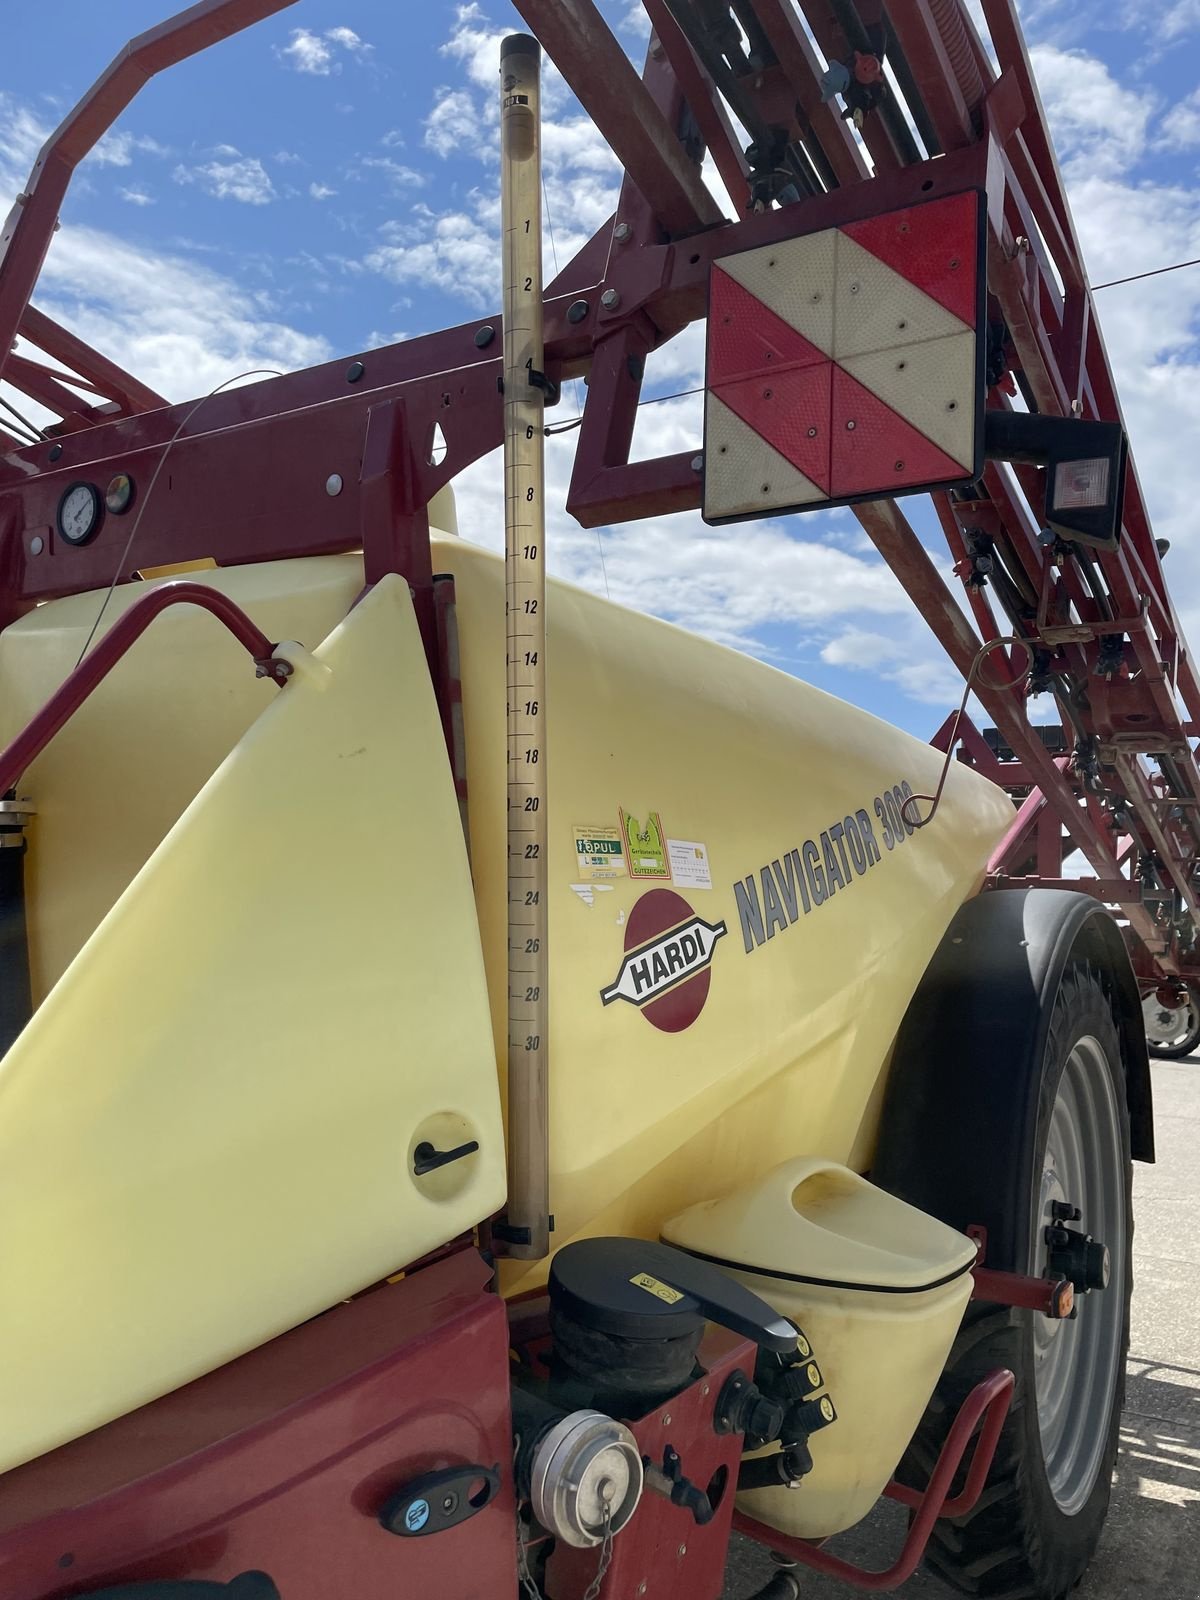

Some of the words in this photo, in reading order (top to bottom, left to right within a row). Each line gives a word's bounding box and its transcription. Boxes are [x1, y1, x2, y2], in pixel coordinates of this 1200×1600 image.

[524, 219, 530, 233] 1
[524, 277, 532, 291] 2
[525, 357, 533, 370] 4
[526, 425, 534, 439] 6
[526, 487, 534, 501] 8
[523, 545, 537, 560] 10
[524, 599, 538, 614] 12
[524, 651, 538, 666] 14
[525, 701, 538, 716] 16
[525, 749, 539, 764] 18
[524, 797, 539, 812] 20
[524, 844, 540, 859] 22
[733, 808, 882, 955] NAVIGATOR
[873, 780, 922, 851] 3000
[524, 891, 540, 906] 24
[525, 938, 540, 954] 26
[629, 927, 707, 996] HARDI
[525, 986, 540, 1002] 28
[525, 1036, 540, 1052] 30
